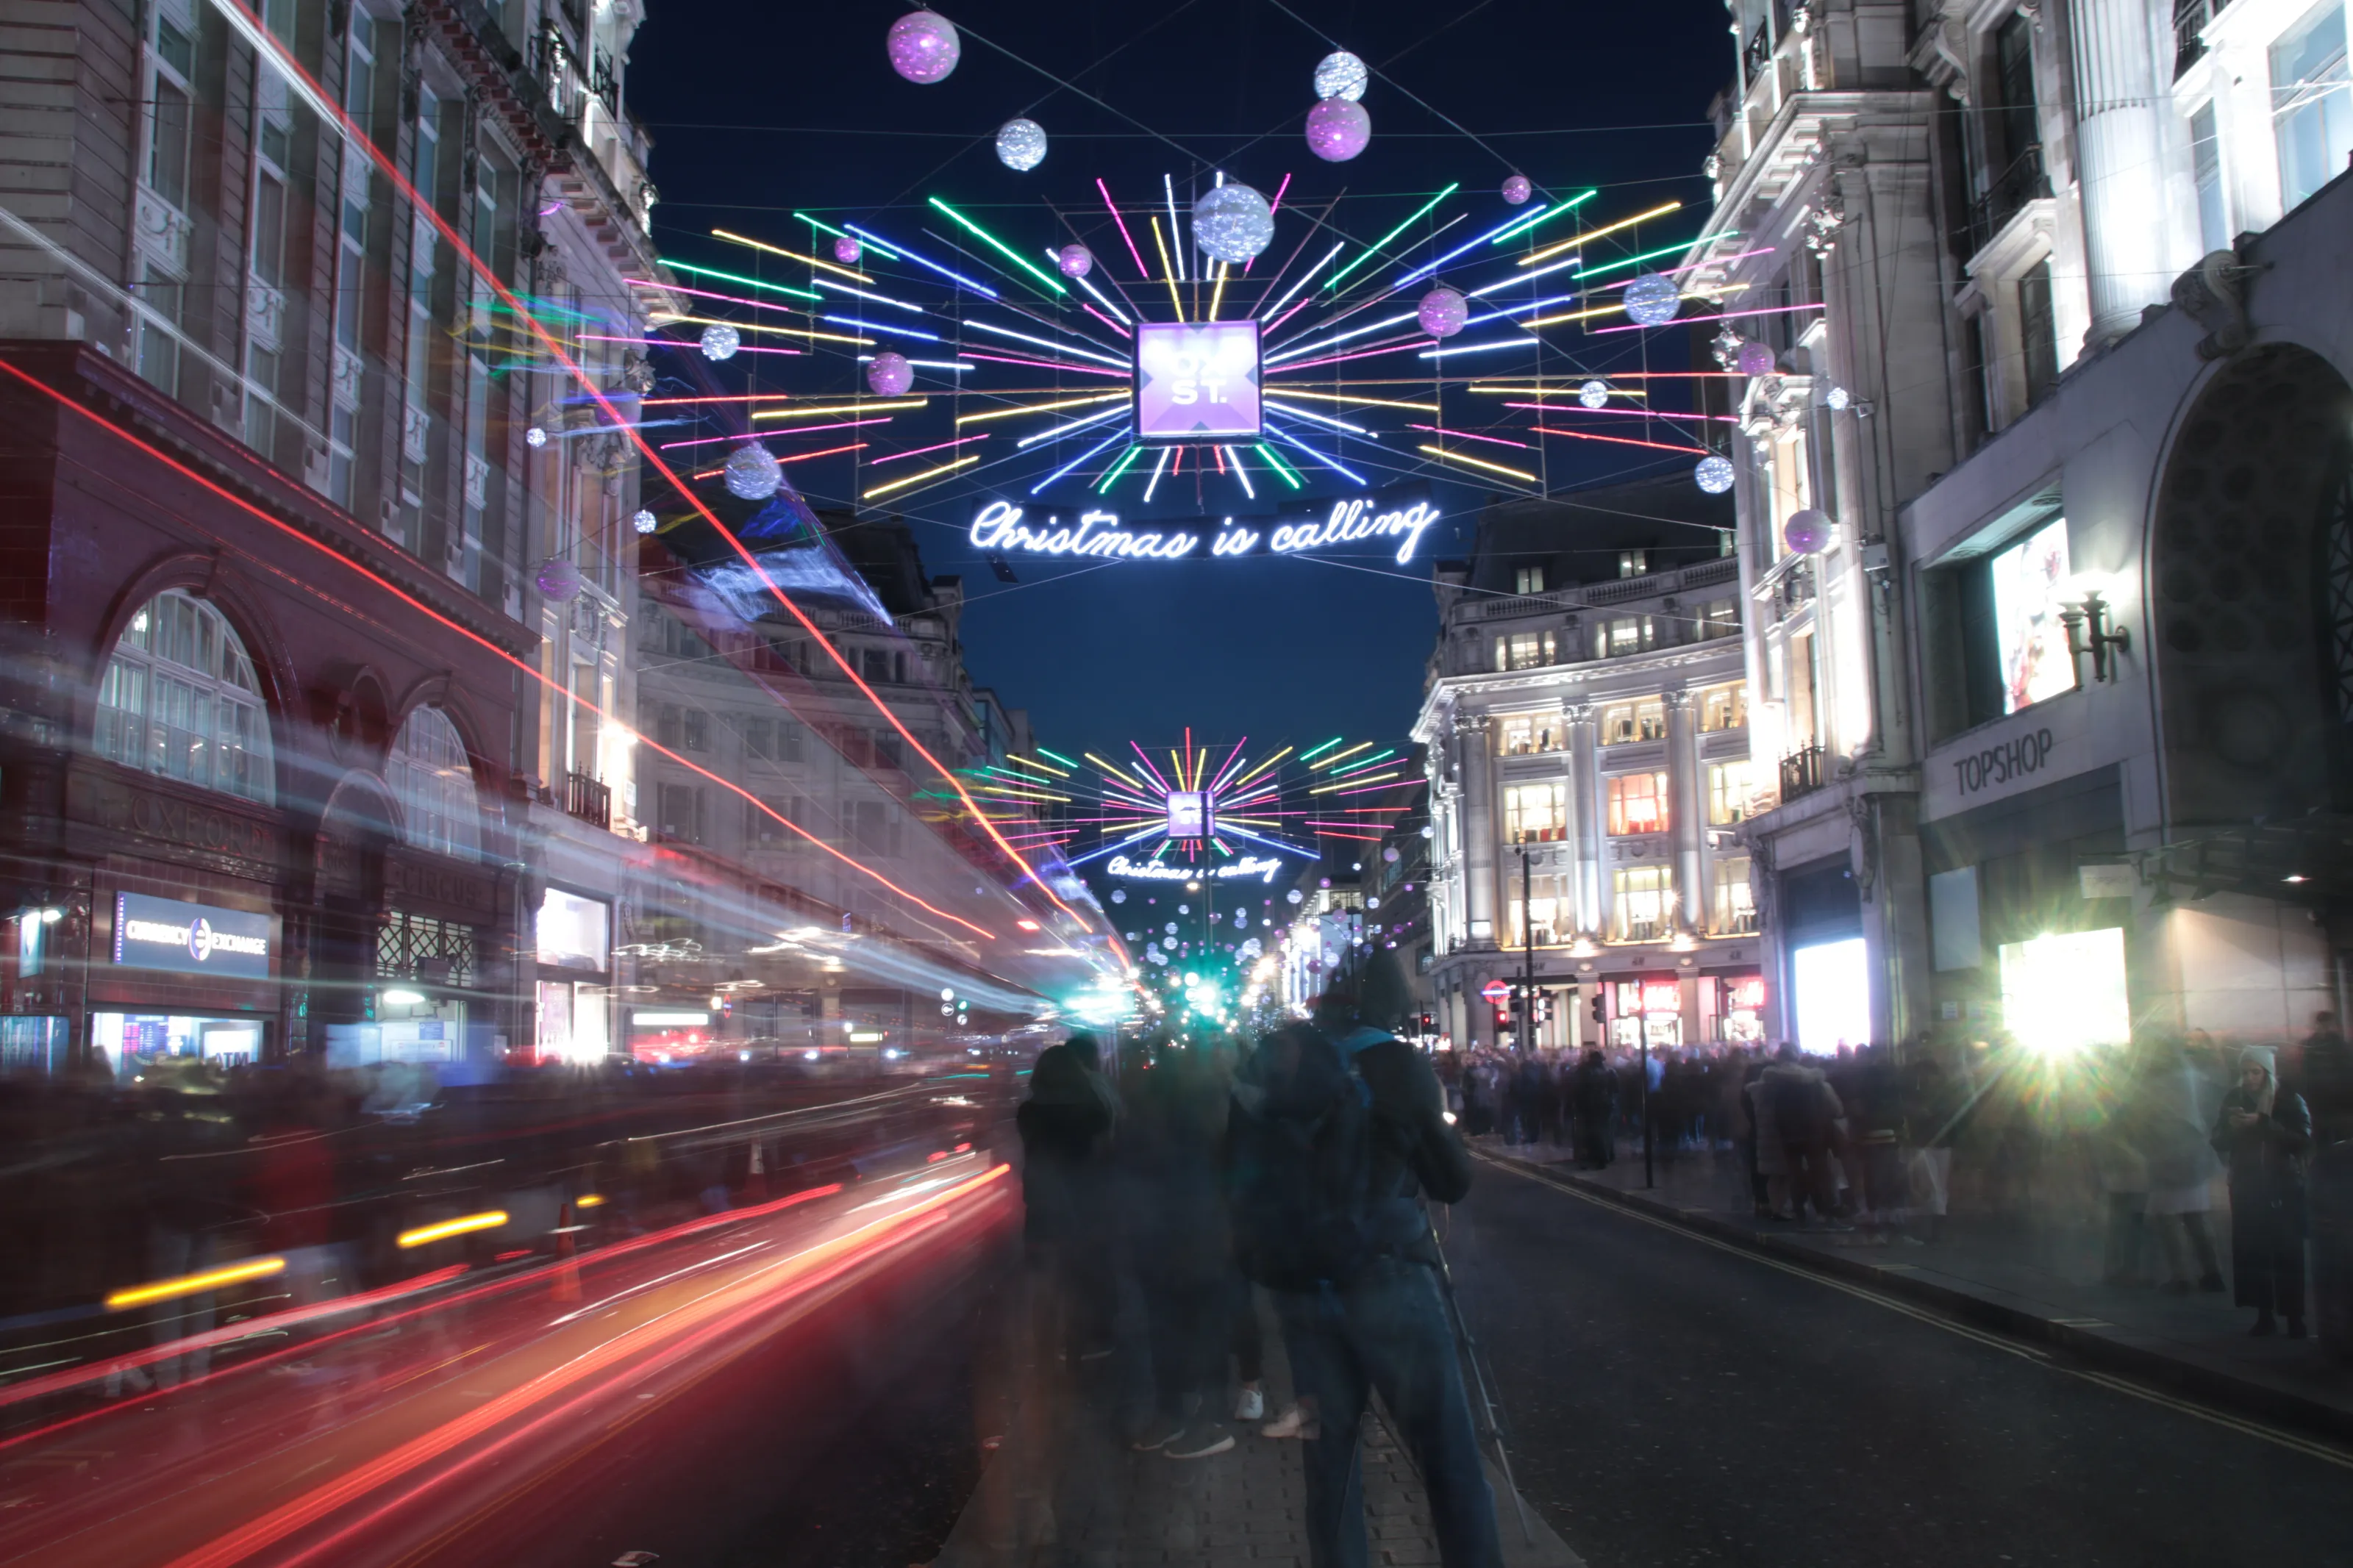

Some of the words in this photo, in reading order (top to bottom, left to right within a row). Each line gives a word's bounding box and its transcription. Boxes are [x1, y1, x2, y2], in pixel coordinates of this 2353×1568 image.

[1171, 379, 1228, 405] ST.
[969, 501, 1198, 559] Christmas
[1212, 516, 1259, 556] is
[1270, 498, 1440, 565] calling
[1953, 728, 2053, 795] TOPSHOP
[132, 796, 265, 856] OXFORD
[402, 866, 478, 906] CIRCUS
[1107, 856, 1193, 879] Christmas
[1217, 857, 1282, 883] calling
[212, 931, 267, 956] EXCHANGE
[216, 1051, 250, 1069] ATM
